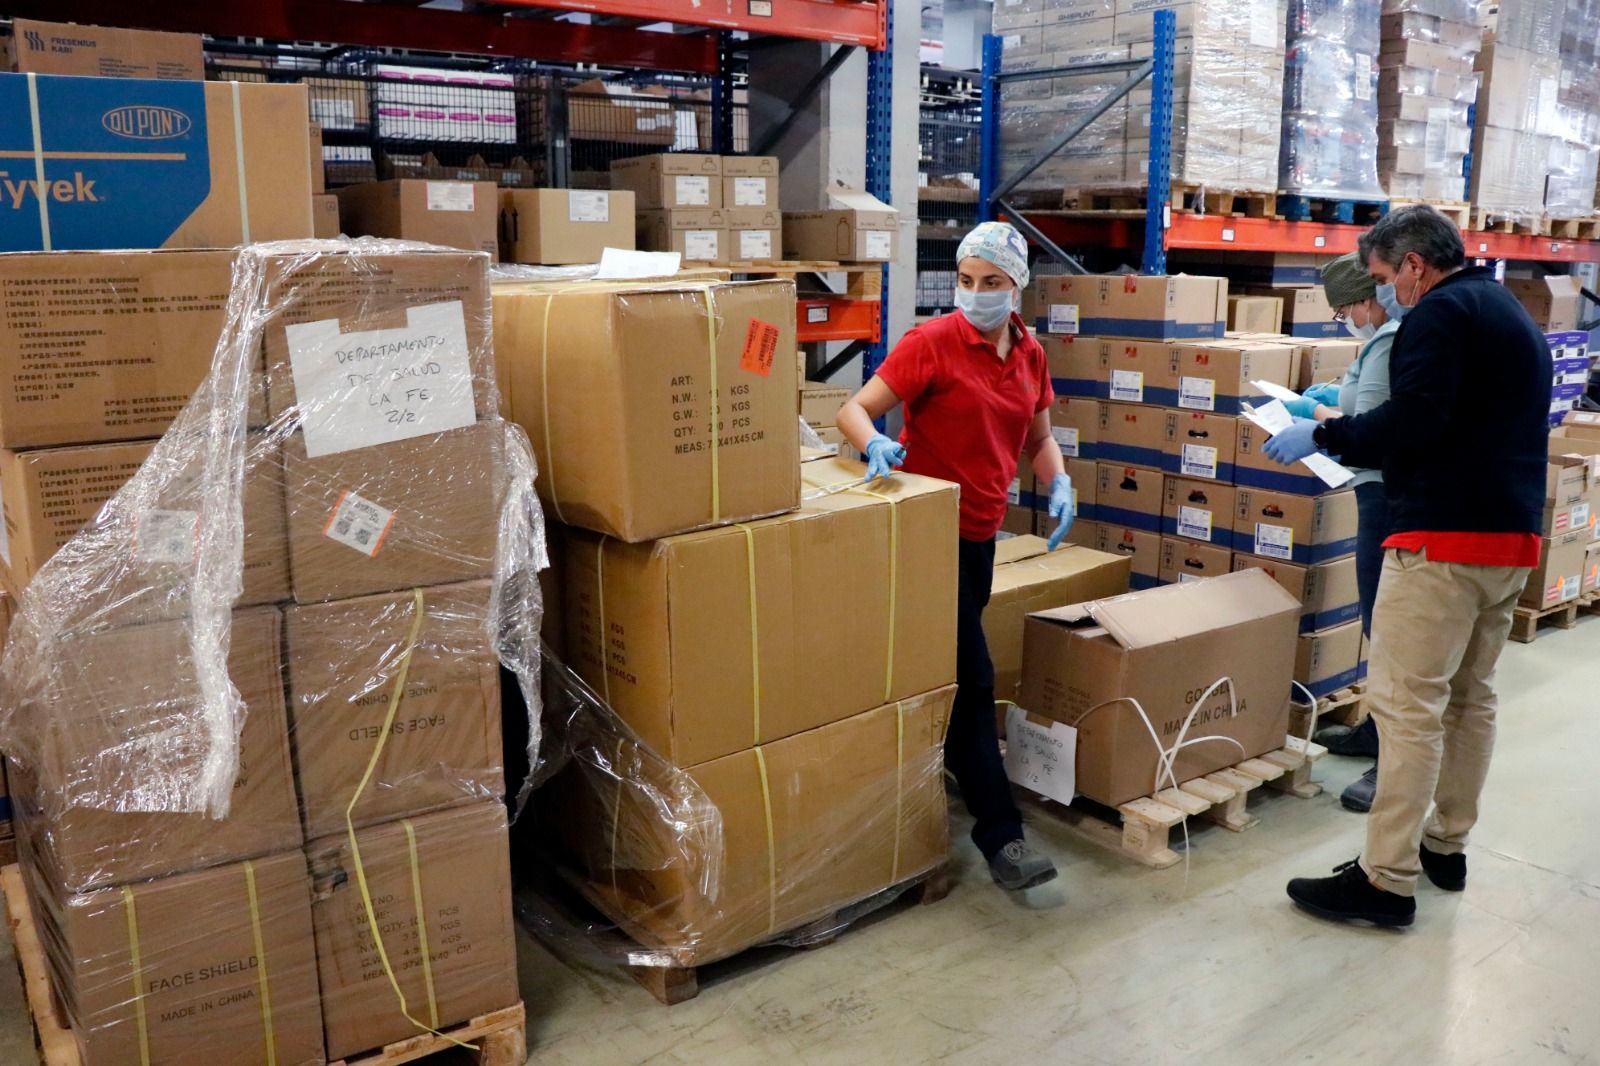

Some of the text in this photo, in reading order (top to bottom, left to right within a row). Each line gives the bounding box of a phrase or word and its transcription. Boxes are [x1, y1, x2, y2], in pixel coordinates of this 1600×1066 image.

[335, 335, 446, 364] DEPARTAMENTO
[347, 361, 441, 388] DE SALUD
[671, 375, 694, 387] ART:
[368, 388, 430, 407] LA FE
[672, 391, 697, 405] N.W.:
[730, 384, 750, 397] KGS
[673, 408, 699, 421] G.W.:
[731, 400, 751, 413] KGS
[674, 417, 751, 438] QTY: 20 PCS
[675, 441, 706, 455] MEAS:
[355, 693, 389, 708] CHINA
[408, 712, 446, 733] FACE
[149, 955, 259, 994] FACE SHIELD
[161, 989, 255, 1022] MADE IN CHINA
